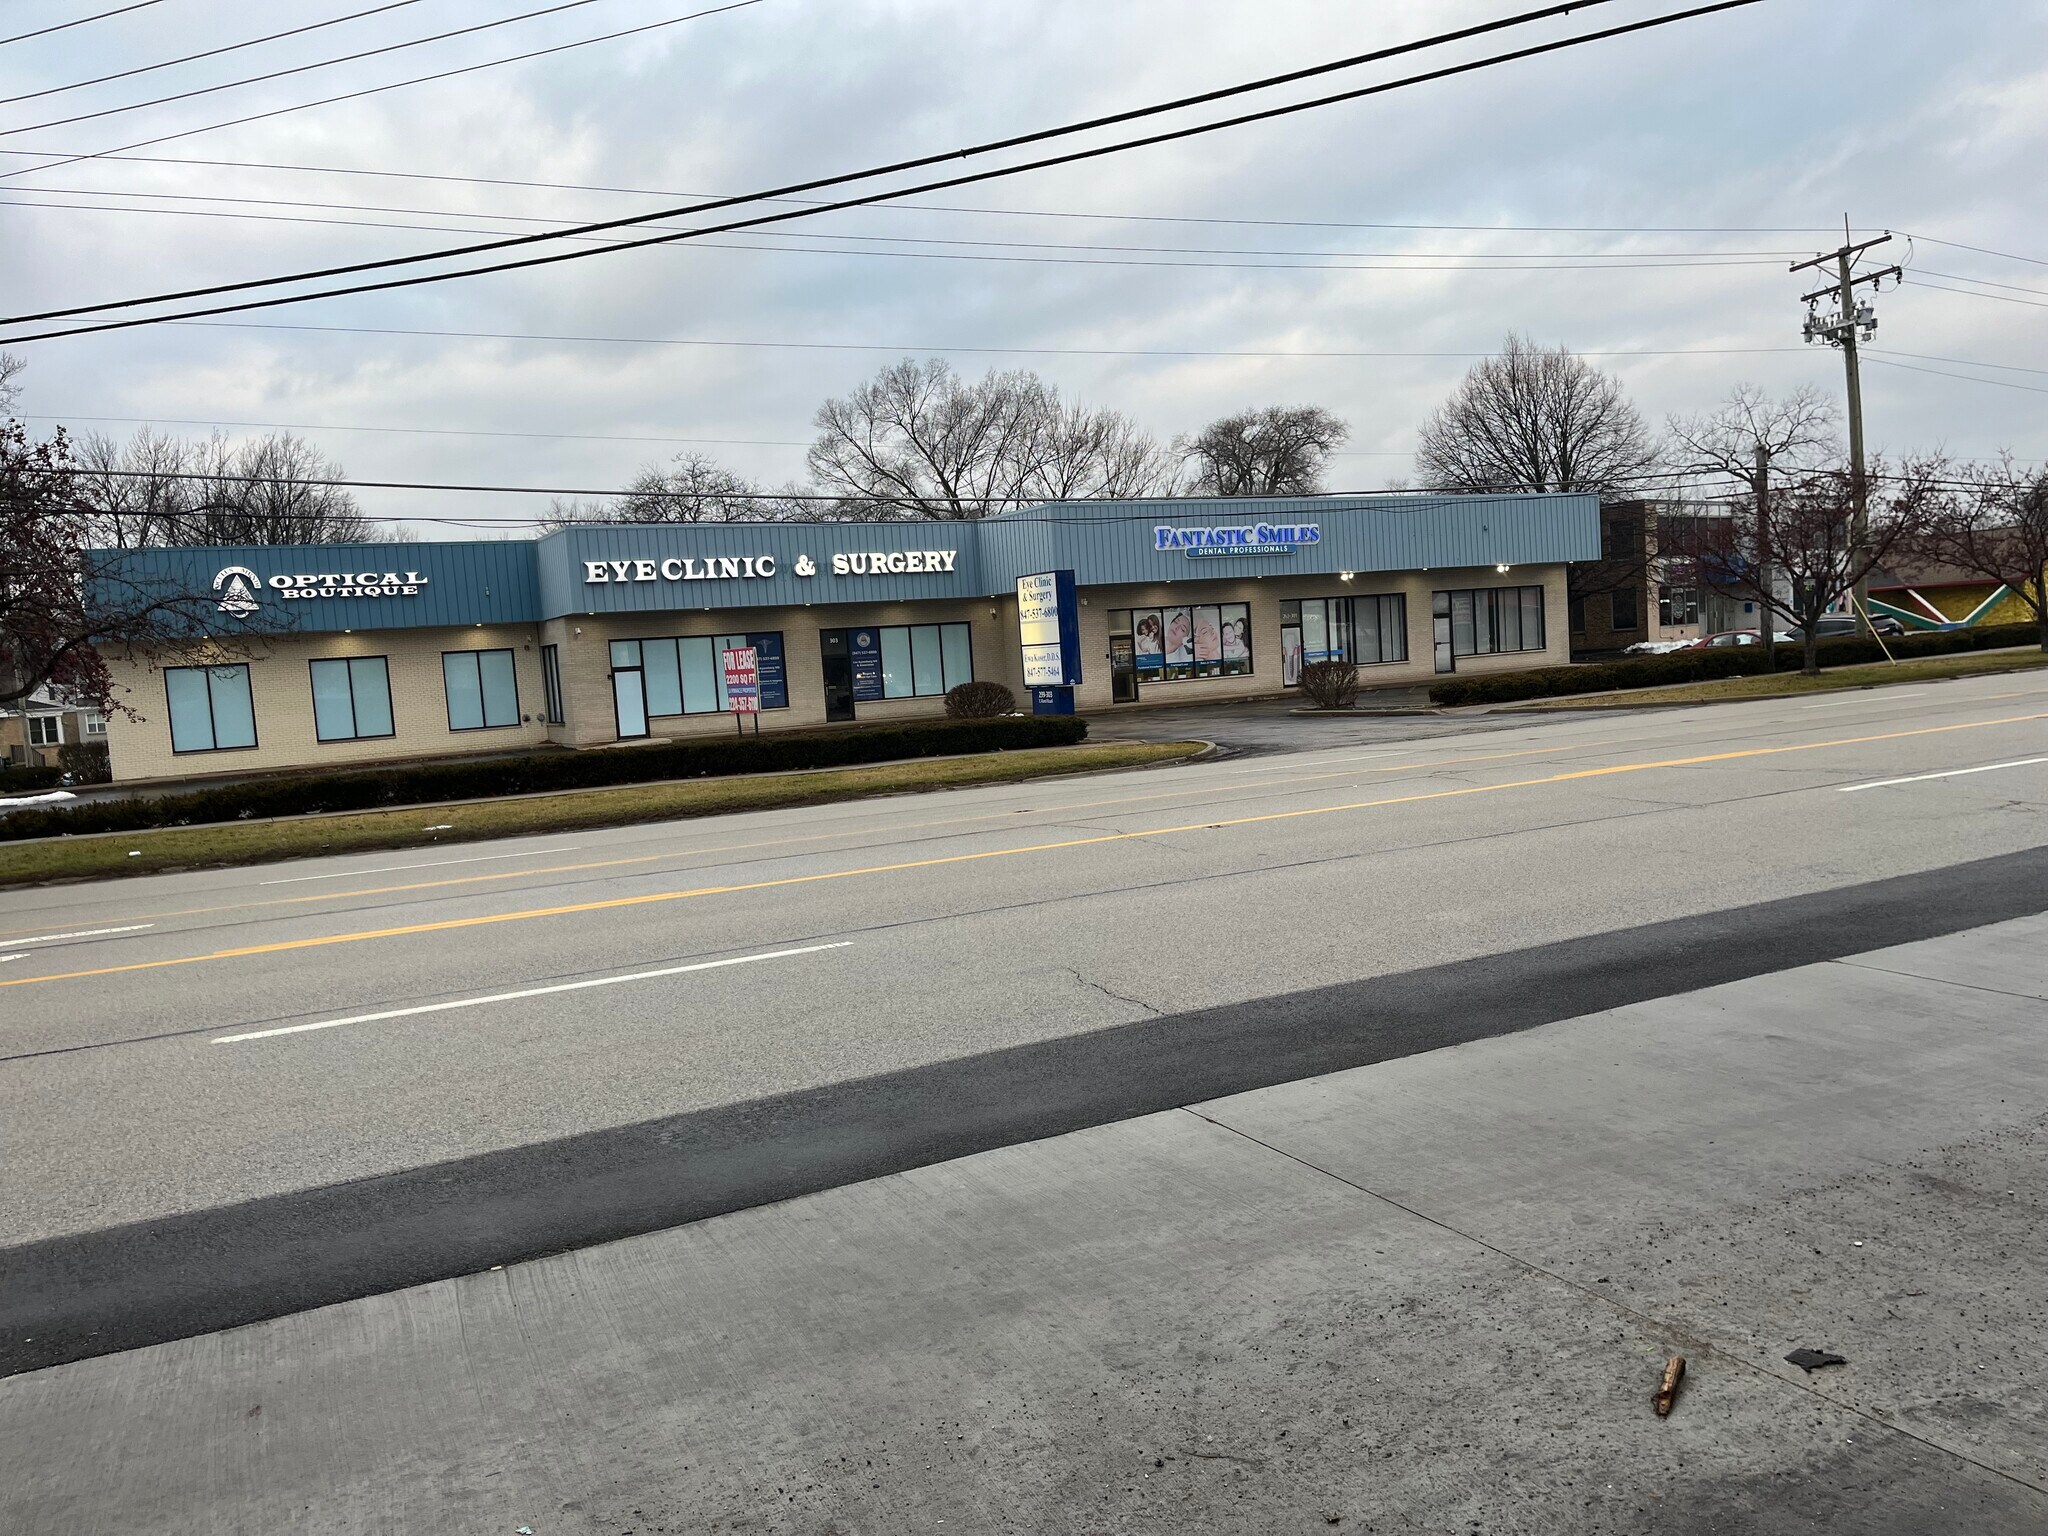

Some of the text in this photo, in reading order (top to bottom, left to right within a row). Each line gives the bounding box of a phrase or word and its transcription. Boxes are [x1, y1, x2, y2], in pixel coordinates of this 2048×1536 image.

[1156, 525, 1320, 548] FANTASTIC SMILES
[1198, 545, 1288, 555] DENTAL PROFESSIONALS
[583, 550, 957, 583] EYE CLINIC & SURGERY
[268, 571, 428, 589] OPTICAL
[1022, 575, 1052, 592] Eye Clinic
[281, 585, 418, 599] BOUTIQUE
[1022, 591, 1052, 603] & Surgery
[723, 649, 755, 671] FOR LEASE
[726, 674, 740, 685] 2200
[740, 674, 748, 686] SQ
[748, 673, 756, 684] FT
